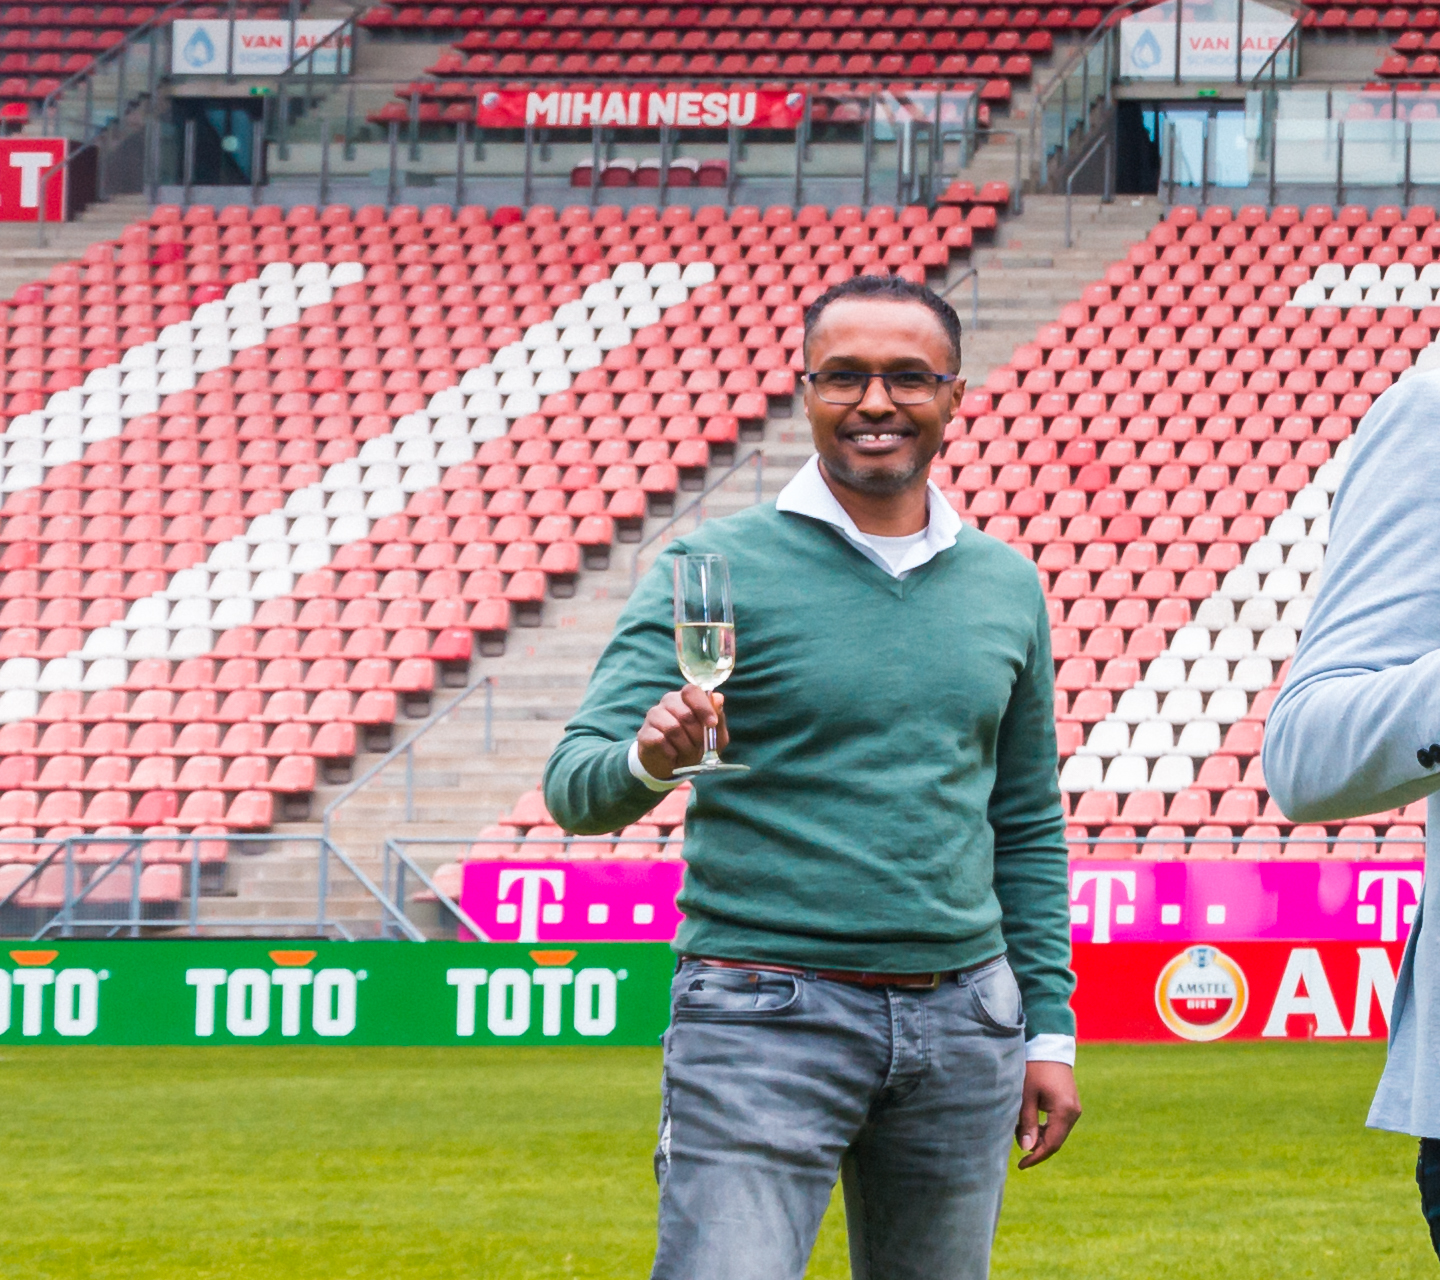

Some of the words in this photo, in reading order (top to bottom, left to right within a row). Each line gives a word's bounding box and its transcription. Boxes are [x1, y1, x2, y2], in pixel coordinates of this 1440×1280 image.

[241, 35, 283, 48] VAN
[1189, 37, 1230, 50] VAN
[526, 91, 641, 126] MIHAI
[648, 91, 757, 126] NESU
[498, 870, 565, 942] T
[1070, 871, 1136, 943] T
[0, 968, 97, 1037] TO
[186, 968, 357, 1037] TOTO
[446, 968, 617, 1037] TOTO
[1176, 983, 1228, 994] AMSTEL
[1187, 999, 1217, 1010] BIER
